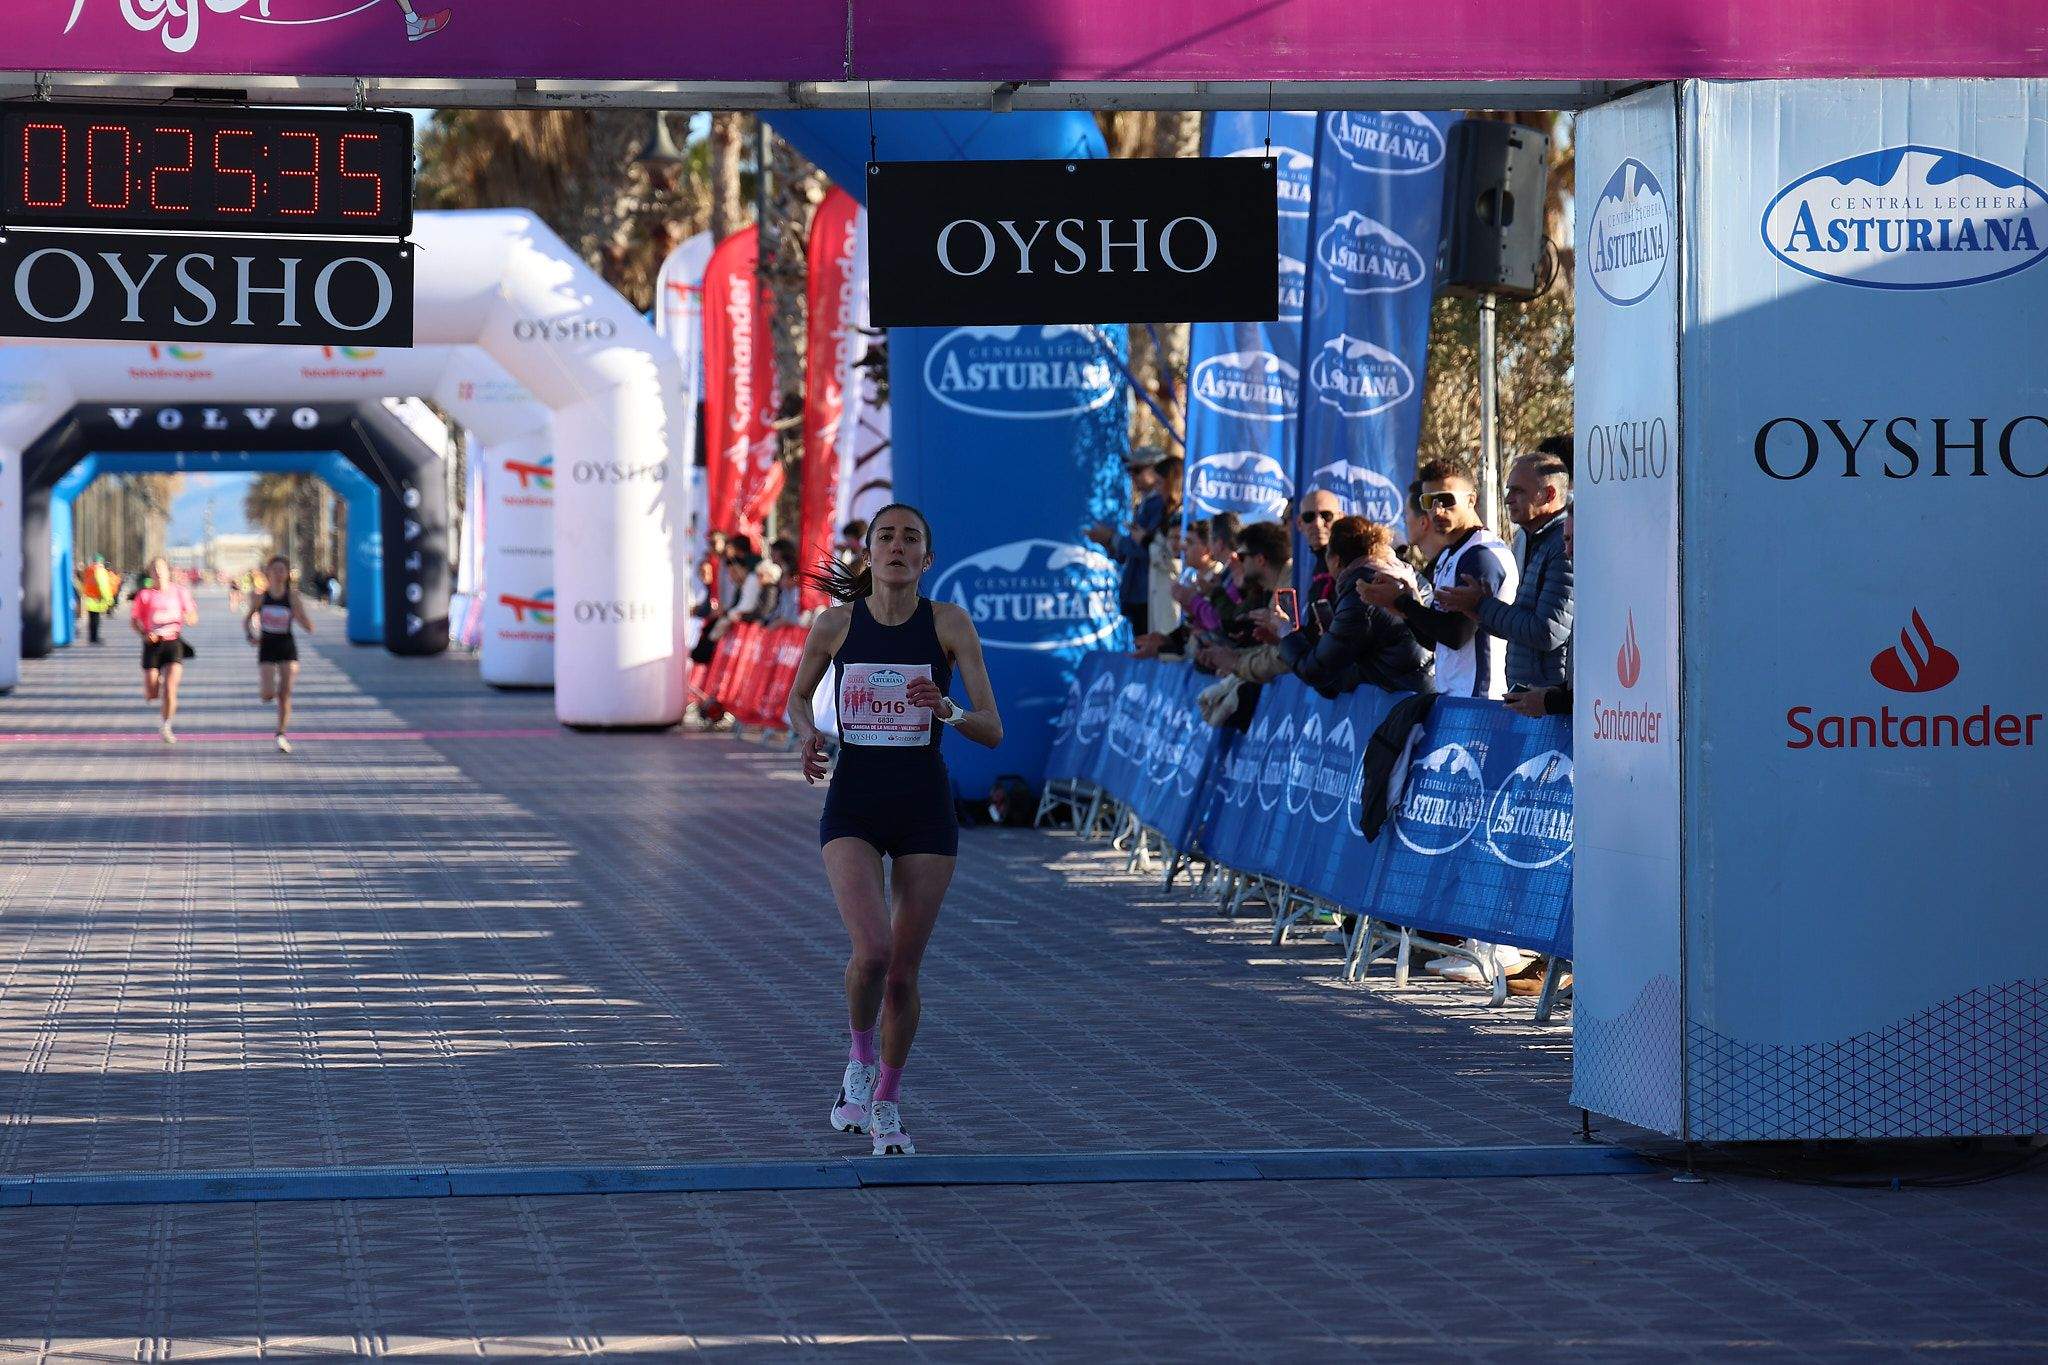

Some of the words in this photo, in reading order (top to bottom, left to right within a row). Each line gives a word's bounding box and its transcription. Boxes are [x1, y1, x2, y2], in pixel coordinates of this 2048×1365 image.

[23, 123, 382, 217] 00:25:35
[1830, 196, 1924, 210] CENTRAL
[1934, 195, 2030, 209] LECHERA
[937, 216, 1217, 276] OYSHO
[1594, 220, 1665, 273] ASTURIANA
[1783, 200, 2040, 254] ASTURIANA
[14, 247, 394, 331] OYSHO
[513, 317, 617, 341] OYSHO
[1200, 368, 1298, 408] ASTURIAN
[107, 407, 320, 430] VOLVO
[1587, 417, 1667, 485] OYSHO
[1754, 416, 2048, 480] OYSHO
[574, 600, 655, 624] OYSH
[872, 700, 905, 714] 016
[1593, 699, 1662, 744] Santander
[1786, 705, 2043, 749] Santander
[1402, 778, 1474, 830] ASTURIANA
